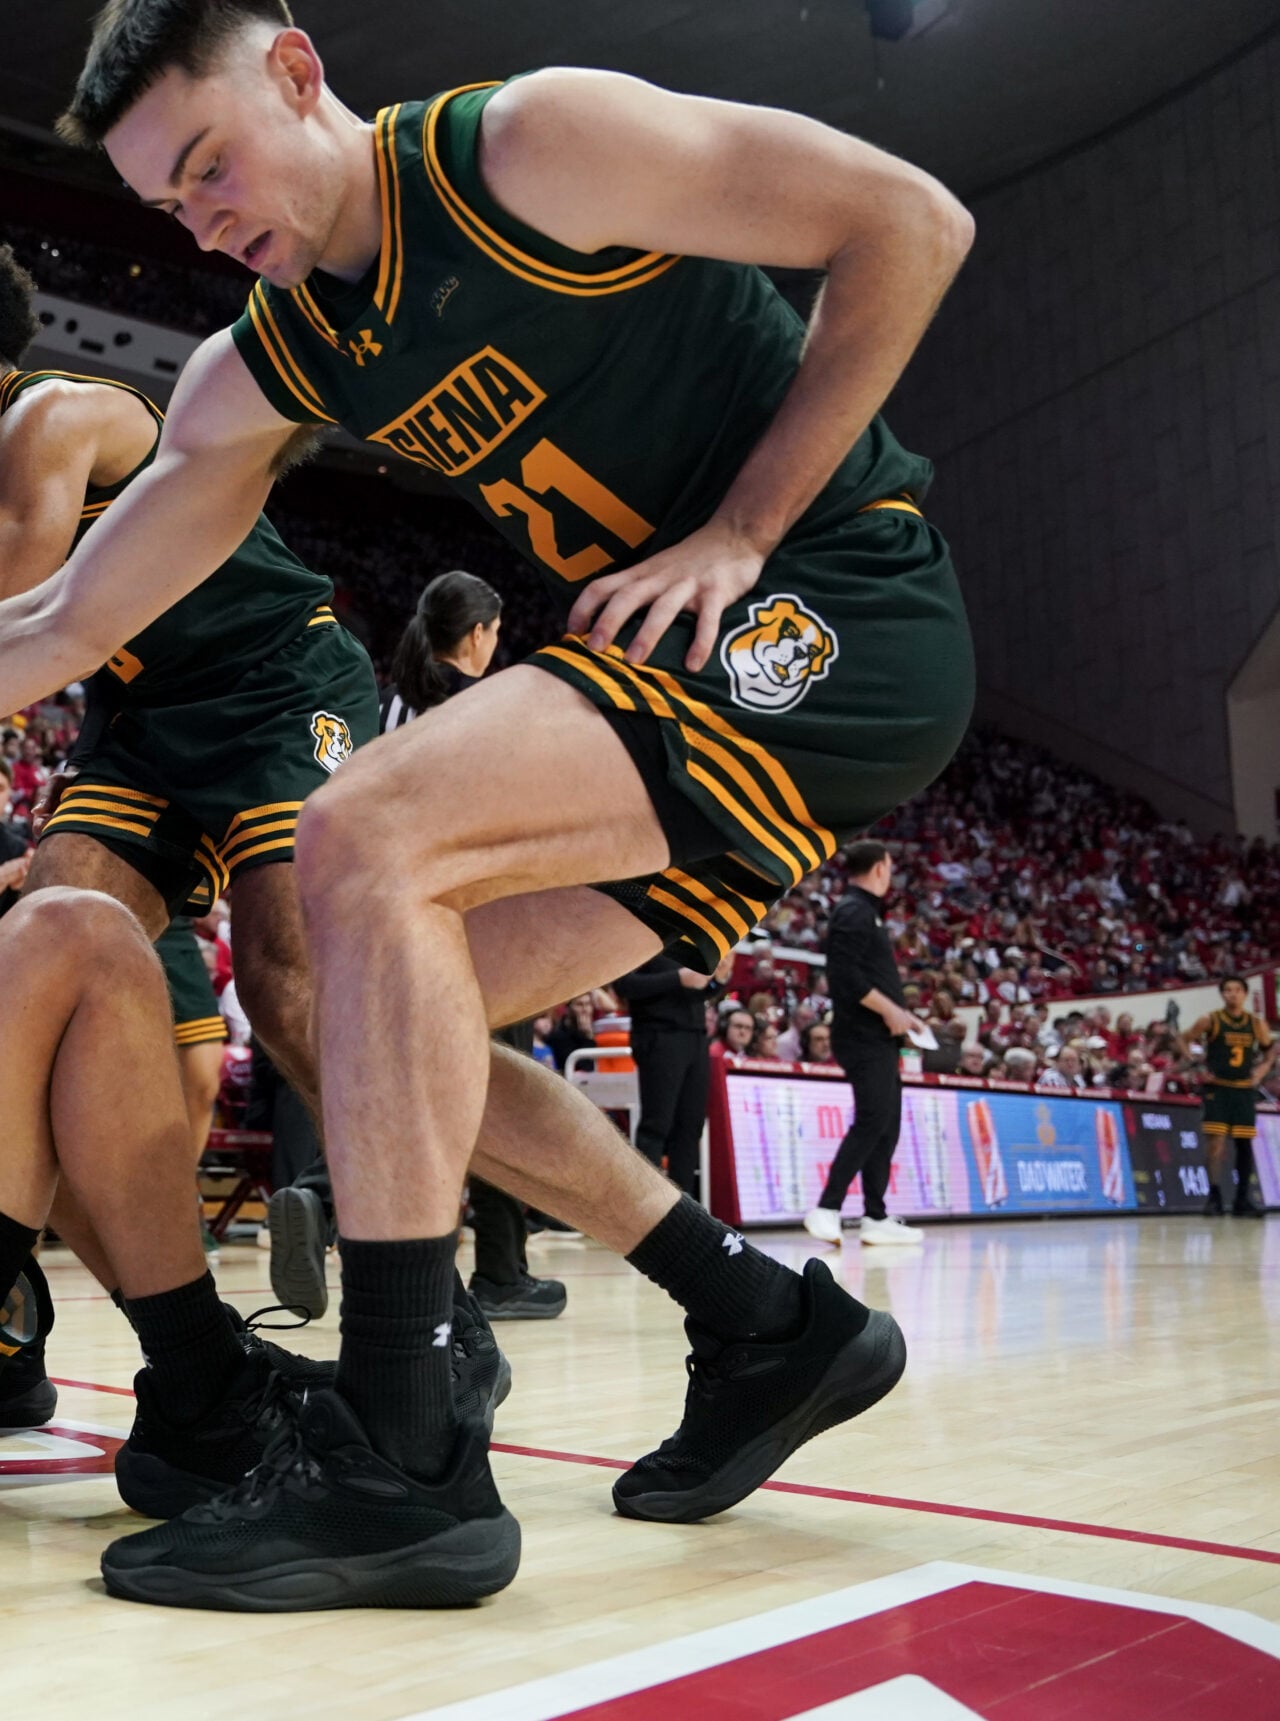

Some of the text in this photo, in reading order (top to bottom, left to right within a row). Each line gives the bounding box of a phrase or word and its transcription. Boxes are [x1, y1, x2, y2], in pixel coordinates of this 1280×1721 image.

[380, 352, 538, 474] SIENA
[478, 437, 657, 583] 21
[1228, 1046, 1245, 1068] 3
